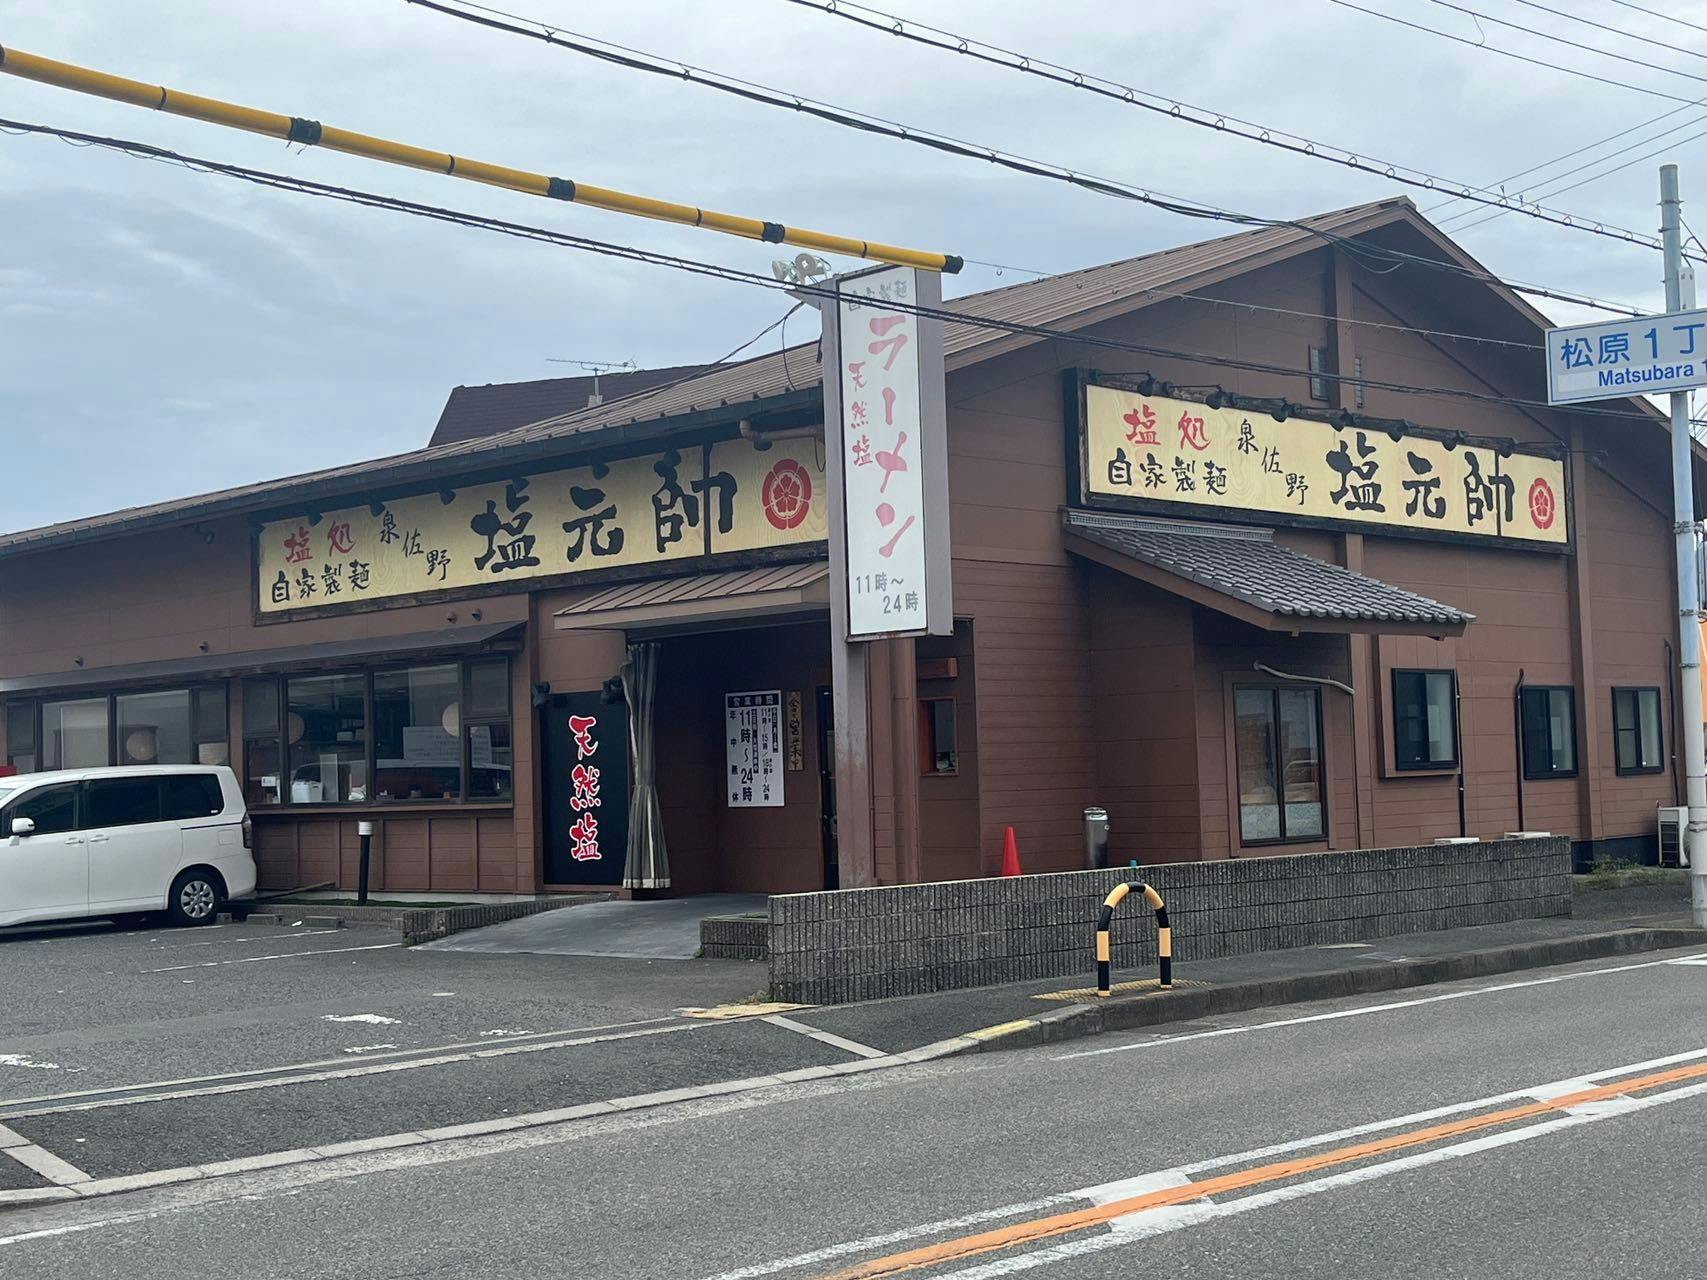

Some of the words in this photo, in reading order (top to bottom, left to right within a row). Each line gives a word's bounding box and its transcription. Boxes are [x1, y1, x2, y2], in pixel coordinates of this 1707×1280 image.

[1560, 323, 1705, 370] 松原1丁
[1599, 363, 1694, 387] Matsubara
[848, 361, 873, 467] 天然塩
[868, 314, 916, 558] ラーメン
[1123, 404, 1212, 451] 塩処
[1107, 448, 1228, 496] 自家製麺
[1237, 418, 1308, 506] 泉佐野
[1326, 432, 1516, 527] 塩元帥
[284, 519, 355, 564] 塩処
[470, 450, 738, 574] 塩元帥
[379, 511, 452, 583] 泉佐野
[271, 561, 371, 604] 自家製麺
[883, 590, 919, 615] 24時
[569, 715, 602, 861] 天然塩
